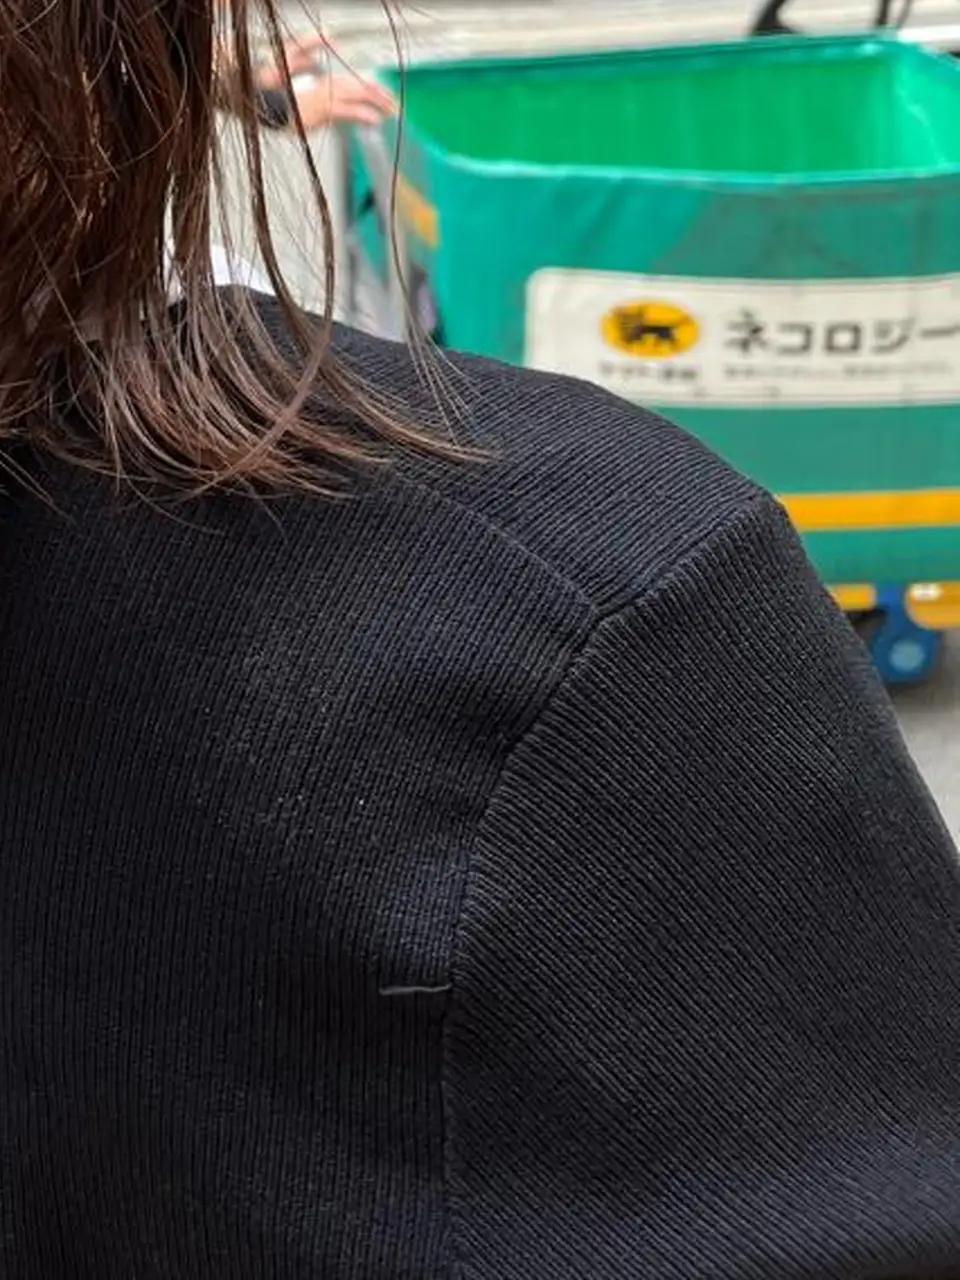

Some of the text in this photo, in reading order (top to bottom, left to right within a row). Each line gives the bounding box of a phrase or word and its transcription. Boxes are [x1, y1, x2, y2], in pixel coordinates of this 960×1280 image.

[724, 307, 960, 358] ネコロジー
